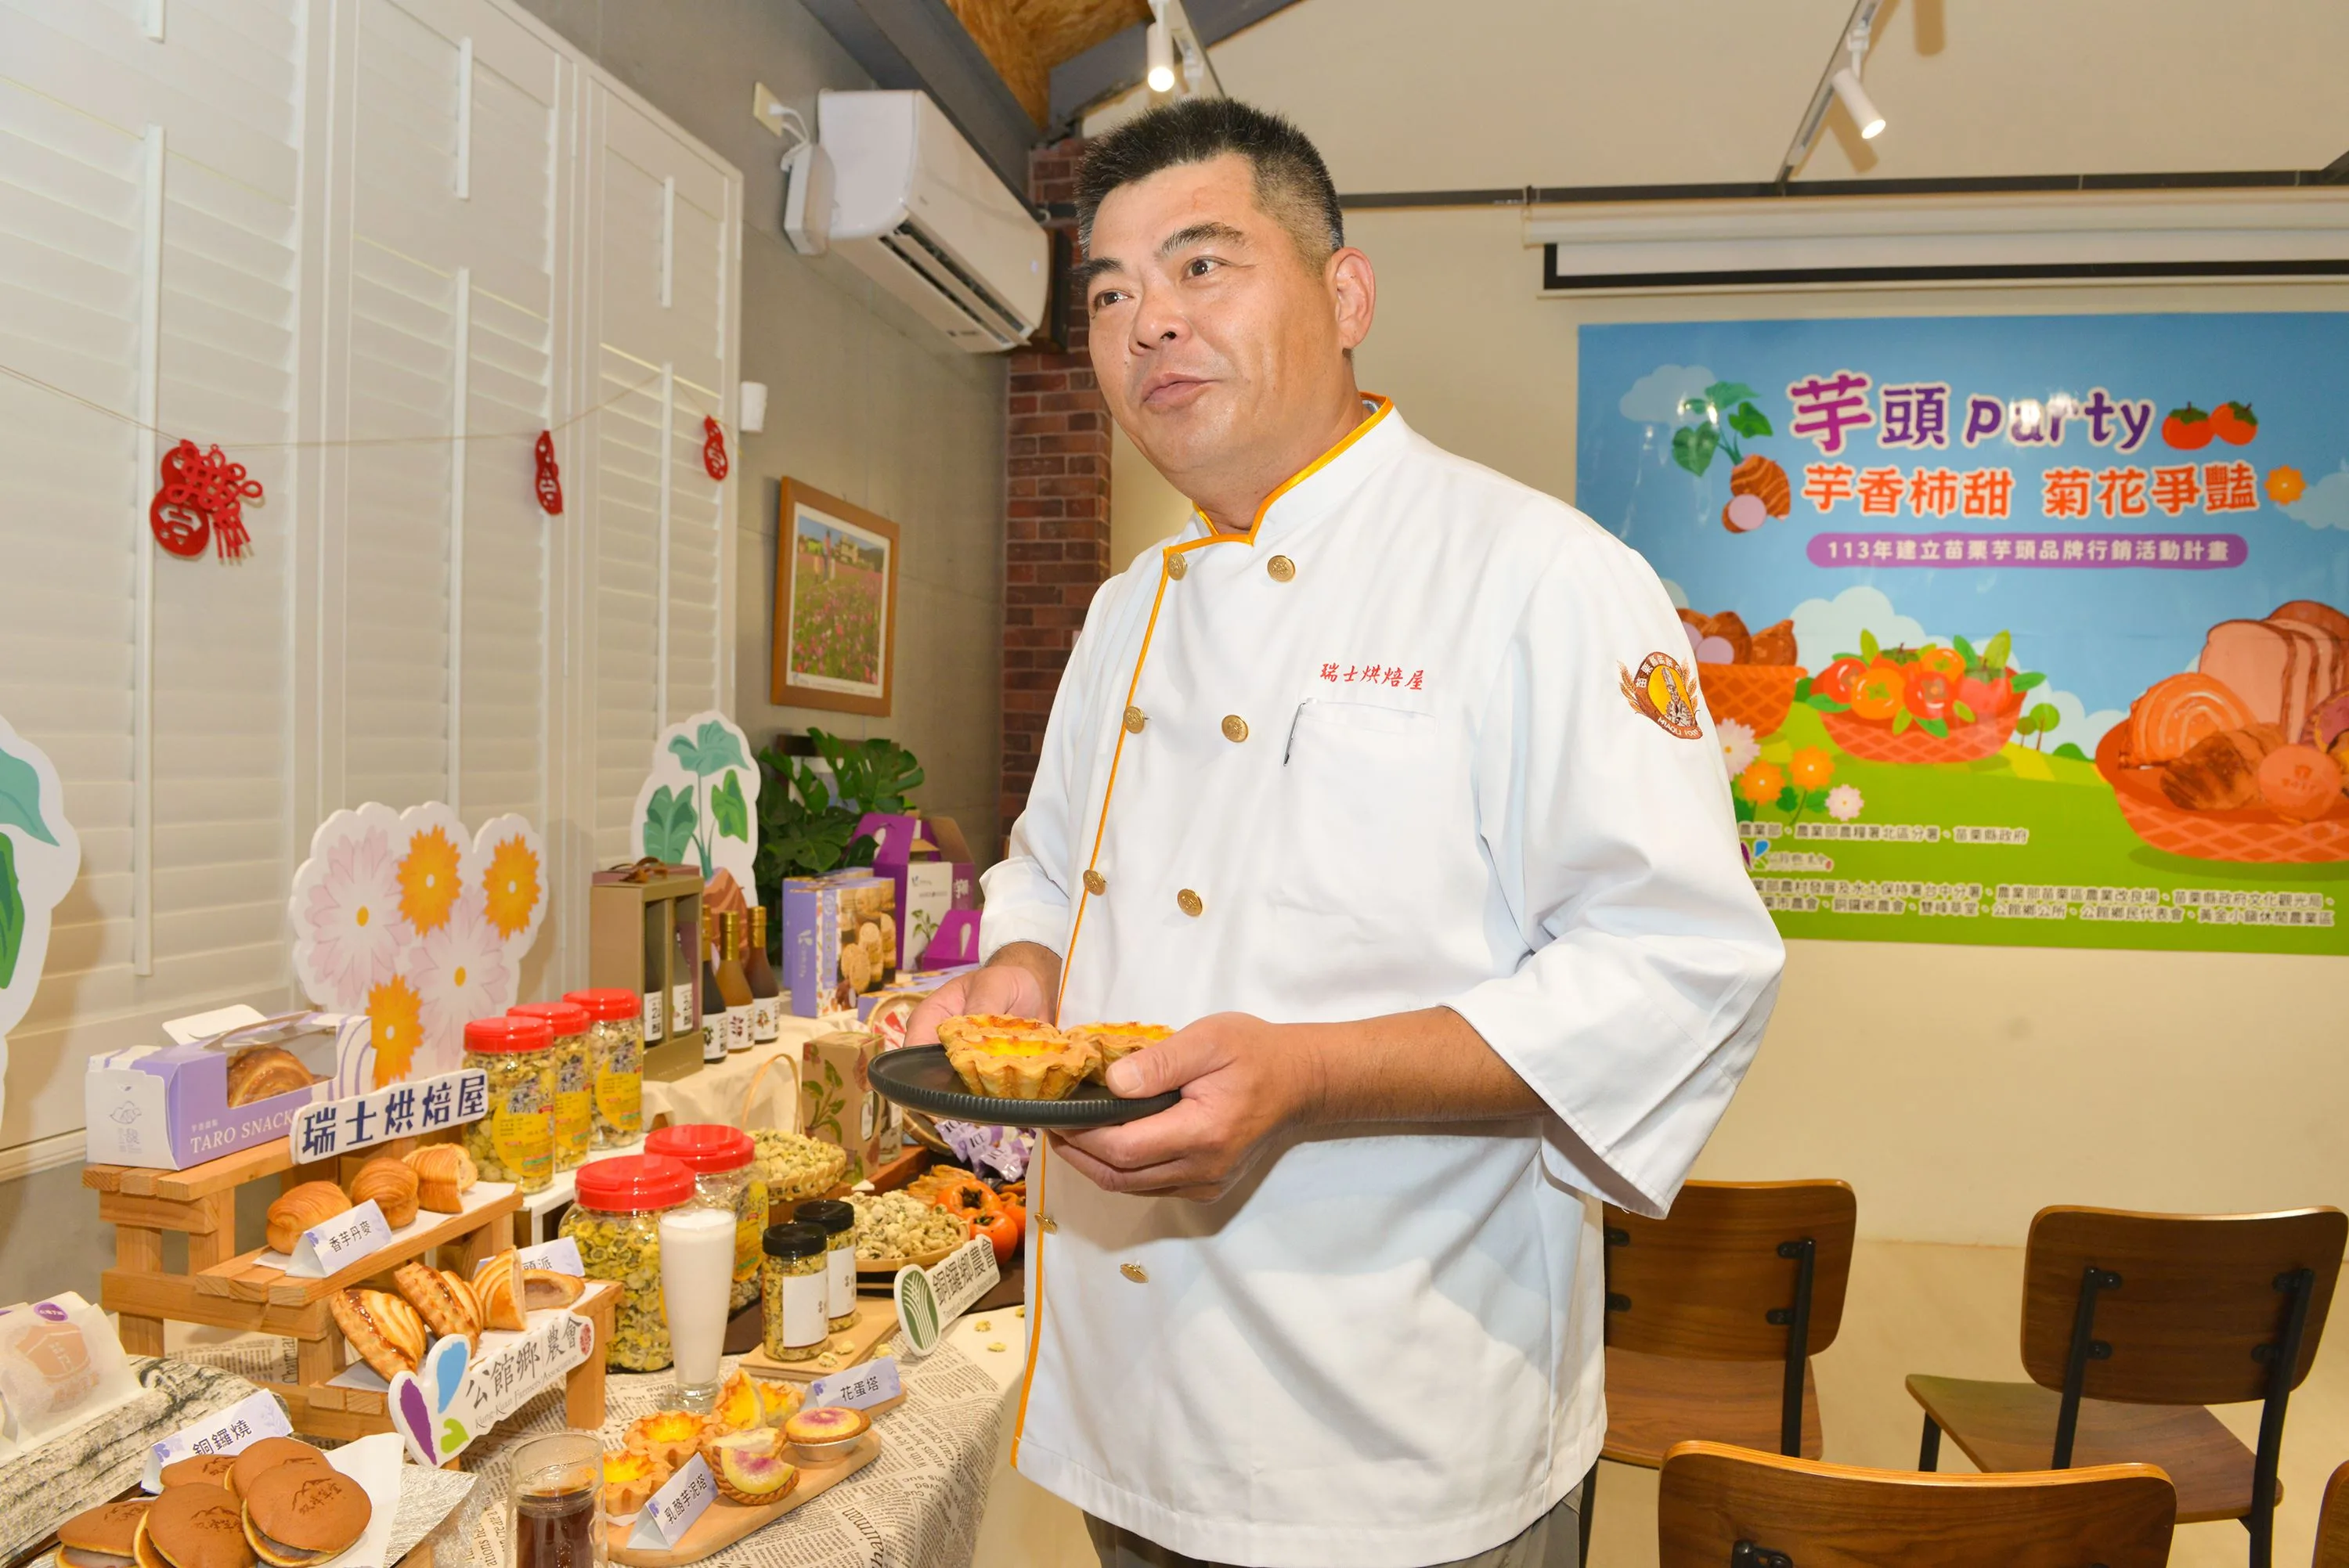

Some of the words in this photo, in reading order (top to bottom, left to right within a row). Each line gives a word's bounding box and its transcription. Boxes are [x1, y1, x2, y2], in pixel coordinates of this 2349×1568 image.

[1791, 374, 1948, 452] 芋頭
[1965, 392, 2152, 450] party
[1803, 465, 2013, 517] 芋香柿甜
[1828, 539, 2229, 563] 113年建立苗栗芋頭品牌行銷活動計畫
[1320, 661, 1423, 690] 瑞士烘焙屋
[190, 1127, 236, 1154] TARO
[241, 1108, 299, 1138] SNACK
[301, 1075, 486, 1155] 瑞士烘焙屋
[329, 1220, 372, 1253] 香芋丹麥
[466, 1316, 583, 1410] 公館鄉農會
[840, 1376, 880, 1402] 花蛋塔
[192, 1419, 252, 1457] 銅鑼燒
[664, 1473, 708, 1525] 乳酪芋泥塔
[842, 1507, 885, 1568] hairman
